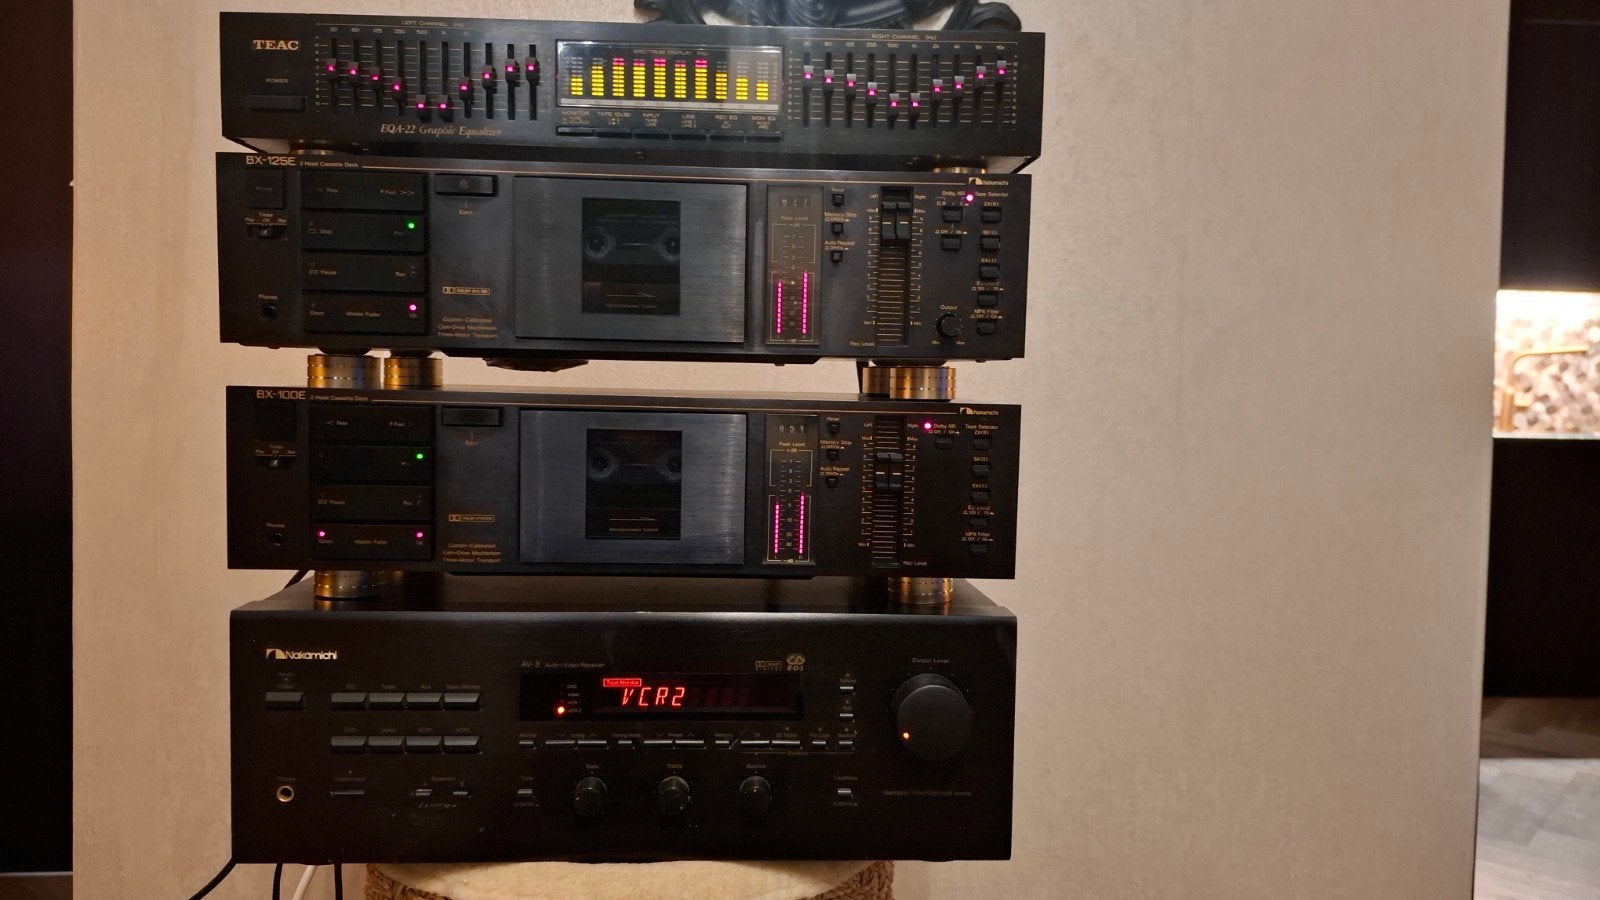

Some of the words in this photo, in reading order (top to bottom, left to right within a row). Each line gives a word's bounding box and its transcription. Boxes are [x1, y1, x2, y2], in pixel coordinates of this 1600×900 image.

[252, 39, 300, 51] TEAC
[380, 123, 416, 135] EQA-22
[419, 125, 456, 138] Graphic
[459, 126, 503, 138] Equalizer
[245, 155, 297, 166] BX-125E
[255, 389, 307, 400] BX-100E
[286, 650, 338, 660] Nakamichi
[621, 686, 686, 707] VCR2
